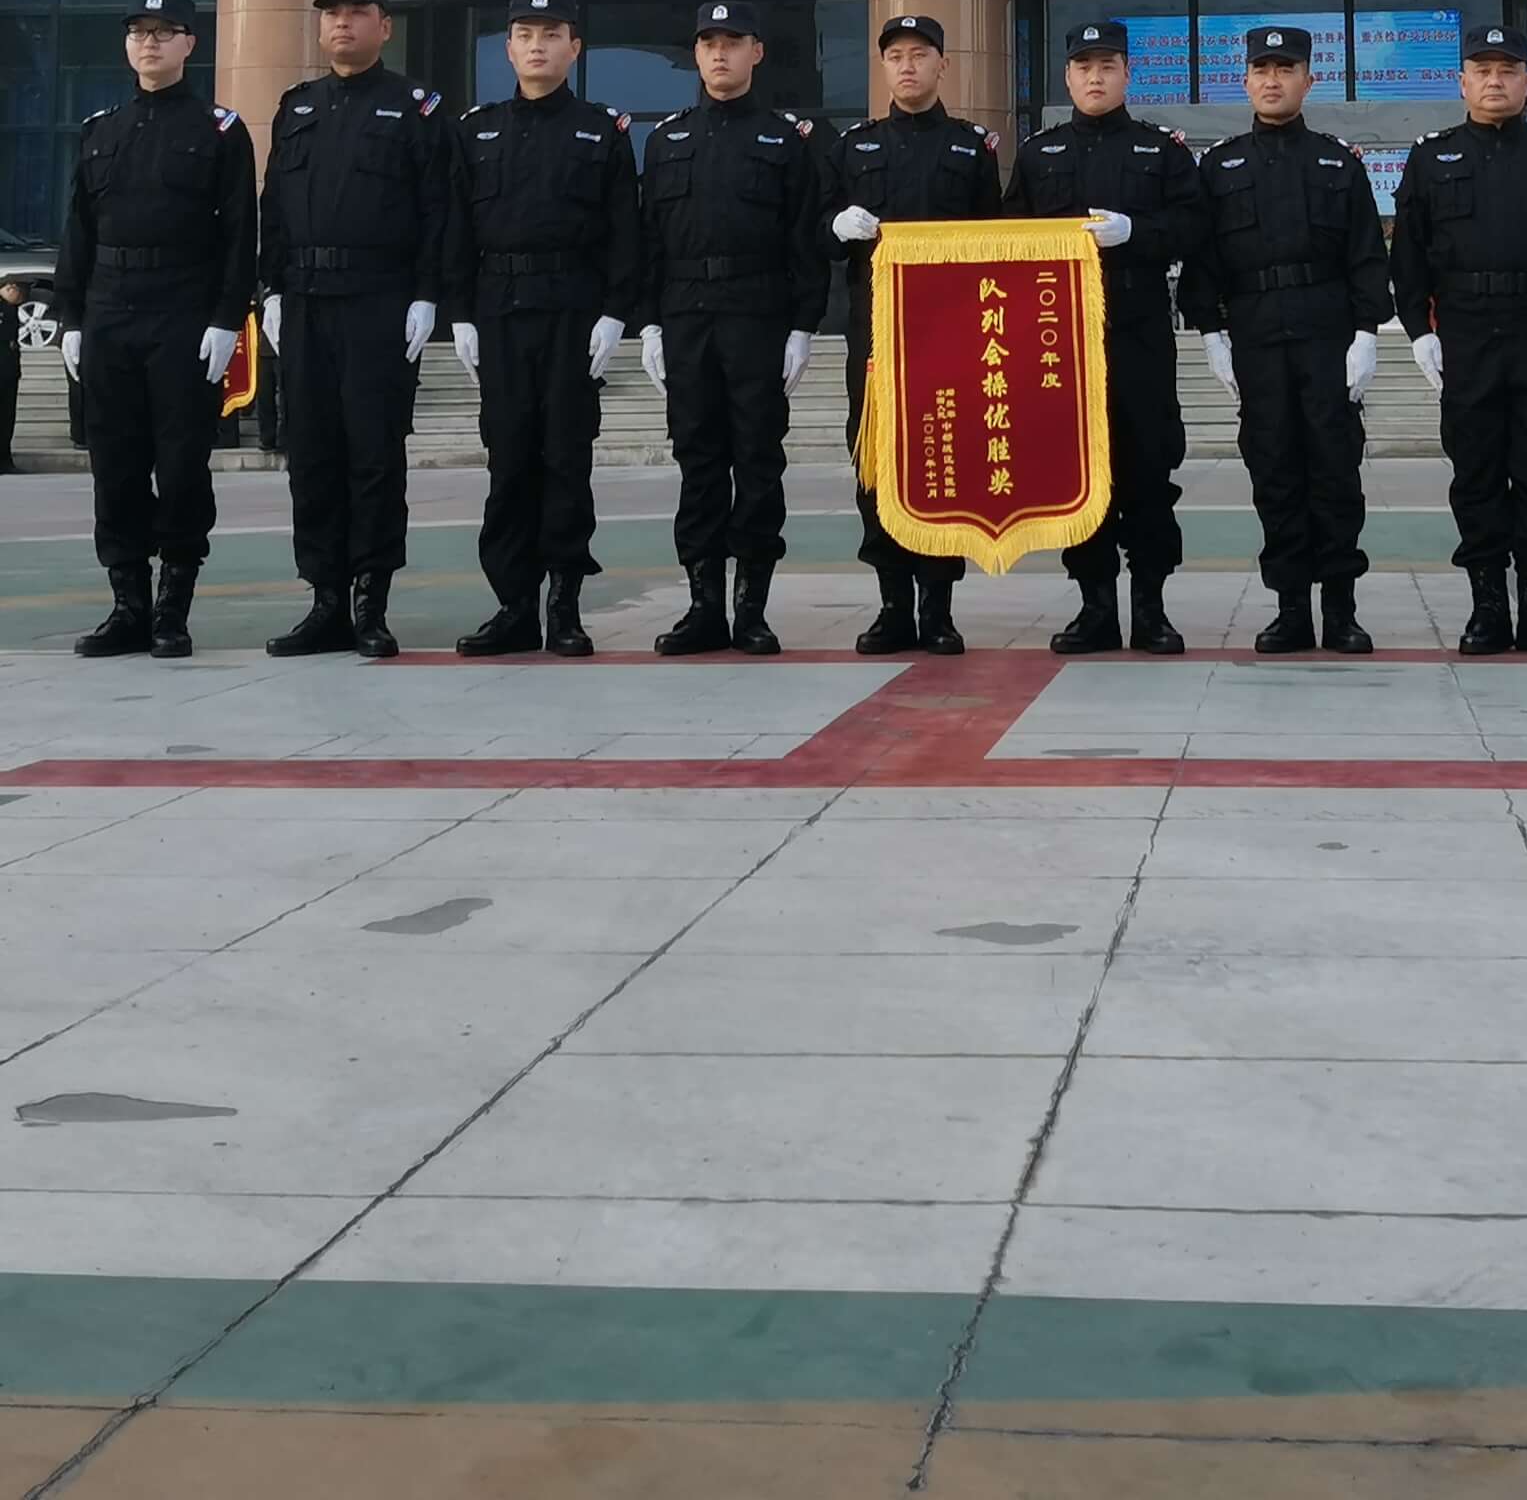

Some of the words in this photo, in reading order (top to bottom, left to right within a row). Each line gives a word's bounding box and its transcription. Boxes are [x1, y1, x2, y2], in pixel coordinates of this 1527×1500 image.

[979, 277, 1014, 496] 队列会操优胜奖
